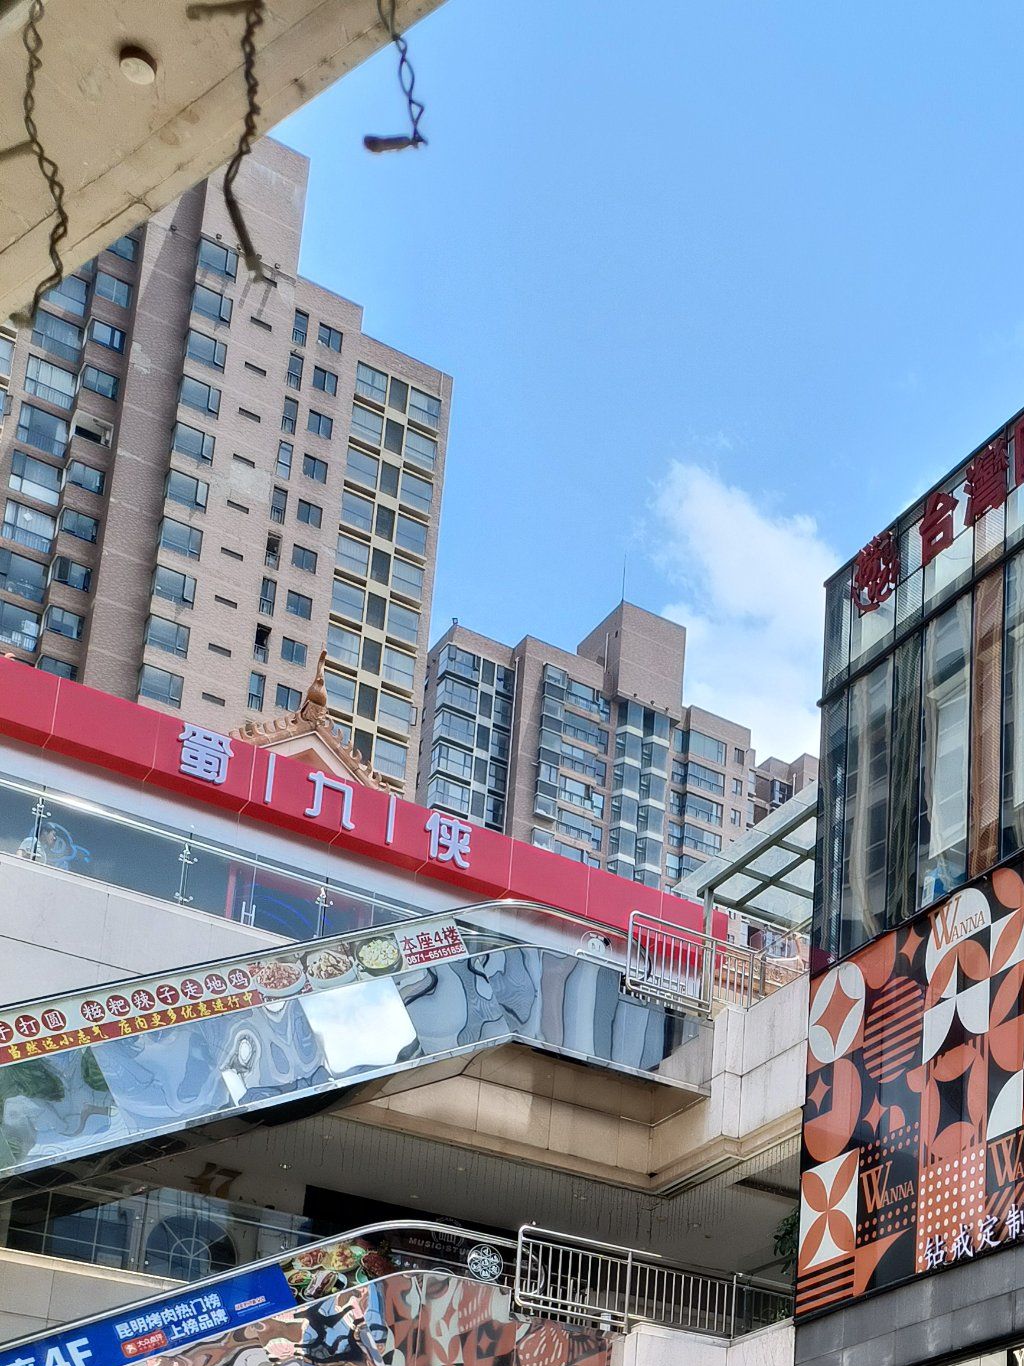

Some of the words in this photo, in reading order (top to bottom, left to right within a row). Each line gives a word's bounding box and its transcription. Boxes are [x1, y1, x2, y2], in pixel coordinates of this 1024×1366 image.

[402, 926, 462, 954] 本座4楼
[927, 894, 985, 951] WANNA
[82, 970, 249, 1021] 糍粑辣子走地鸡
[860, 1161, 915, 1214] WANNA
[115, 1293, 222, 1340] 昆明烤肉热门榜
[170, 1308, 229, 1340] 上榜品牌
